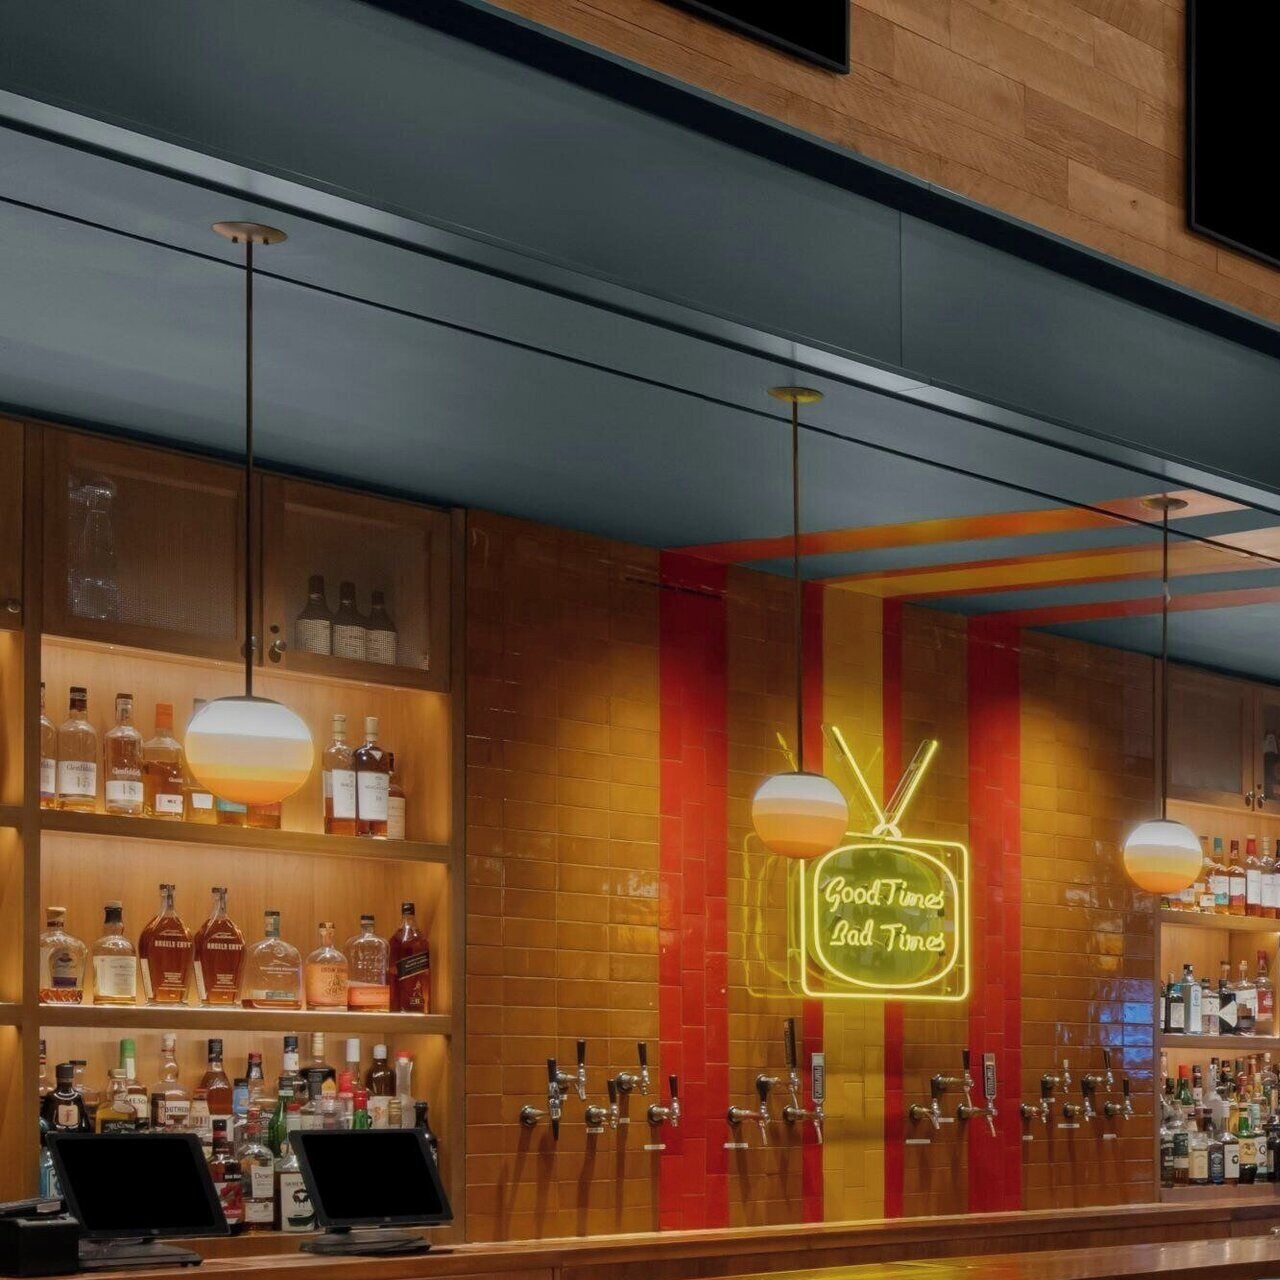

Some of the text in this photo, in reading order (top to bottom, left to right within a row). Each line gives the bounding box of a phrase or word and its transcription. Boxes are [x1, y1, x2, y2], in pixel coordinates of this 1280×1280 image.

[825, 876, 945, 912] Good Times
[829, 919, 946, 951] Bad Times
